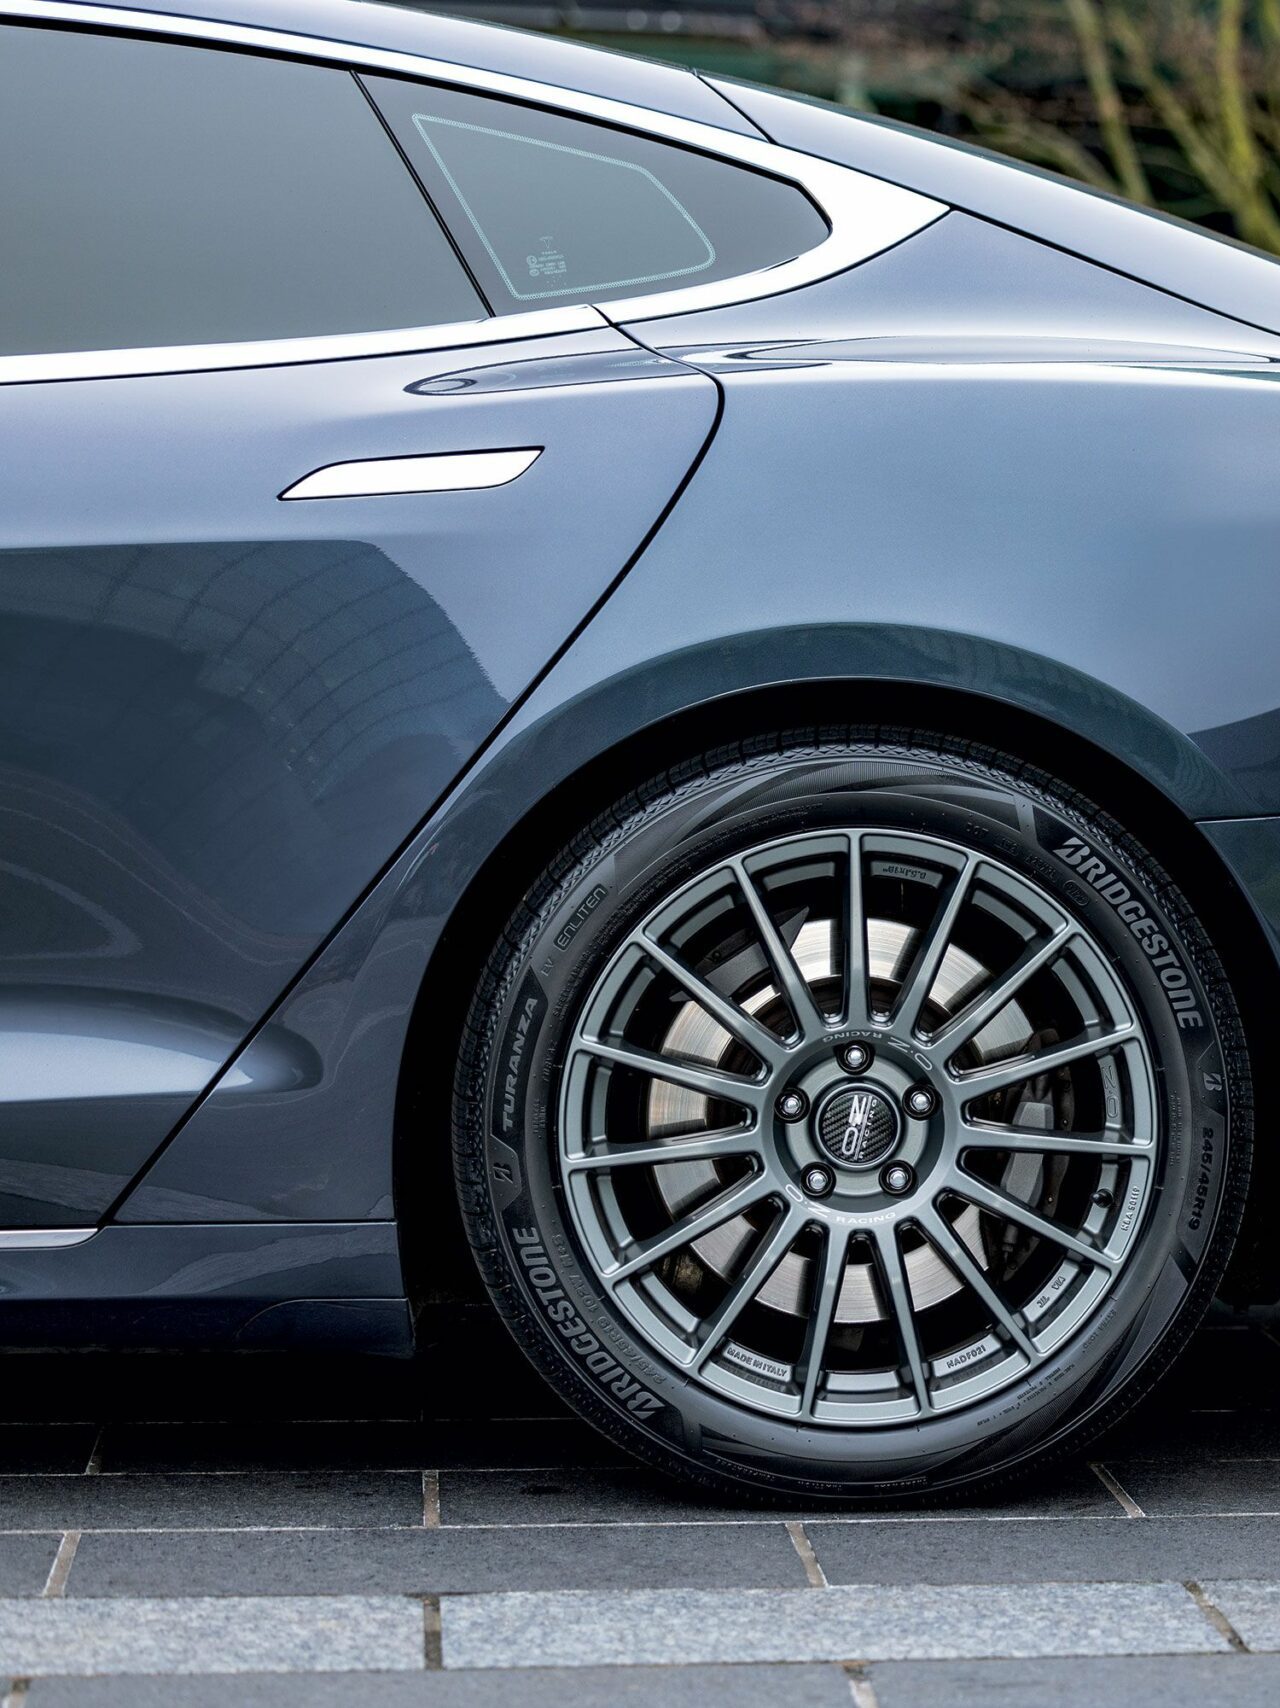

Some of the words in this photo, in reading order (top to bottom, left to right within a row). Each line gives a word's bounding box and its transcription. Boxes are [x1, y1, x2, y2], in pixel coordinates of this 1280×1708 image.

[557, 886, 606, 947] ENLITEN
[1052, 837, 1203, 1029] BRIDGESTONE
[502, 998, 538, 1132] TURANZA
[822, 1031, 883, 1042] RACING
[835, 1211, 897, 1224] RACING
[1187, 1127, 1214, 1231] 245/45R19
[512, 1226, 667, 1420] BRIDGESTONE
[726, 1346, 753, 1366] MADE
[752, 1359, 763, 1370] IN
[762, 1363, 788, 1377] ITALY
